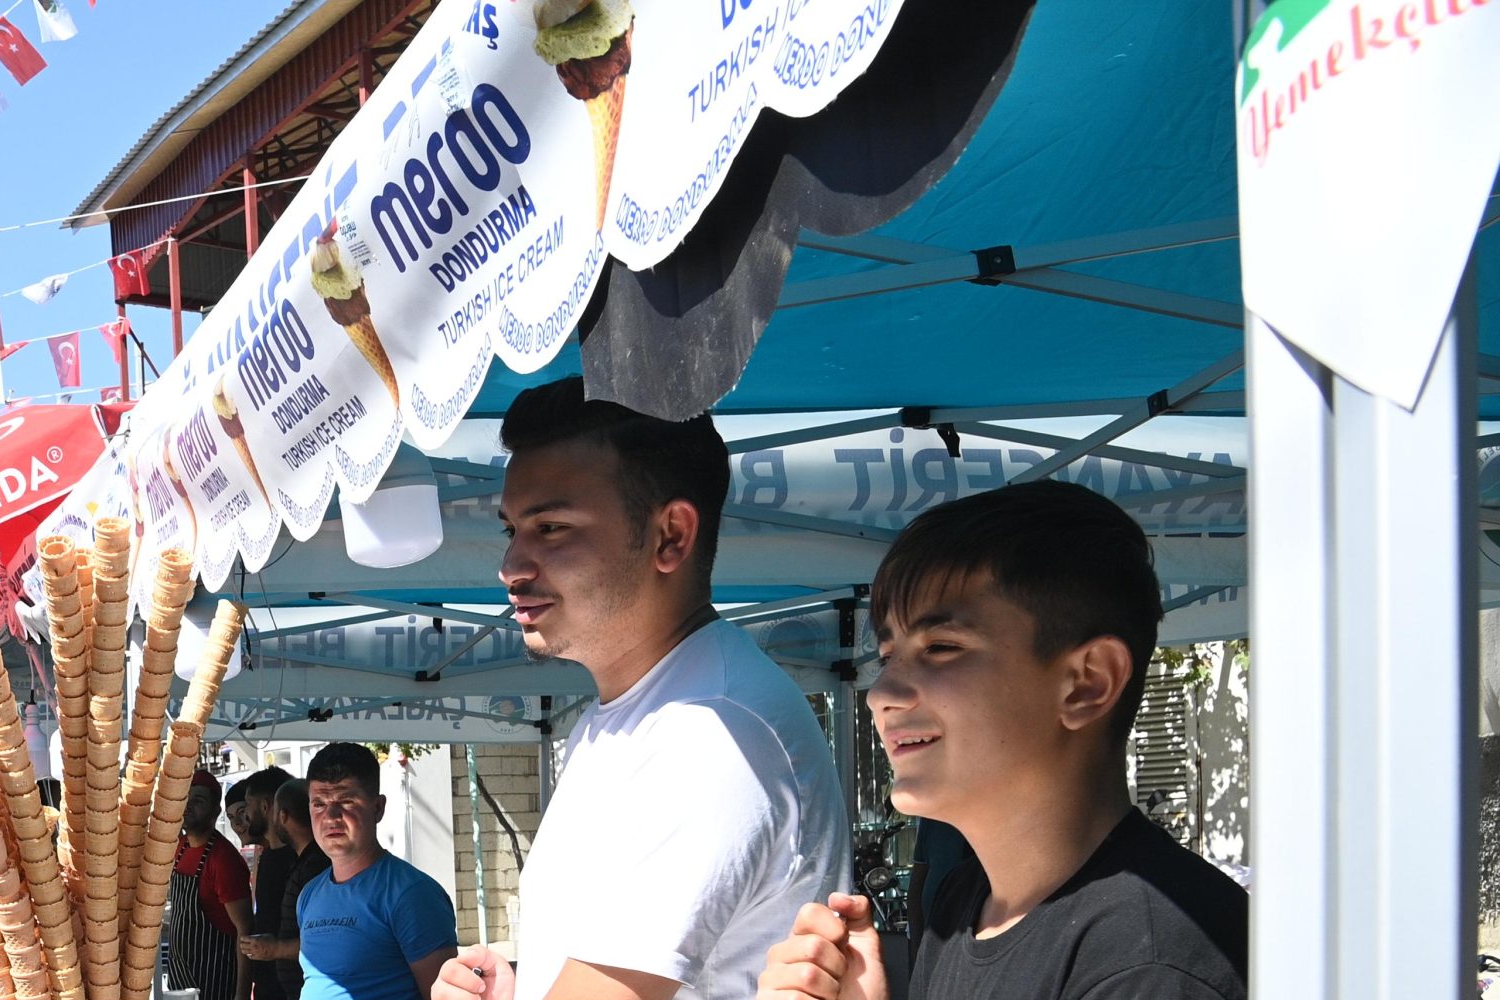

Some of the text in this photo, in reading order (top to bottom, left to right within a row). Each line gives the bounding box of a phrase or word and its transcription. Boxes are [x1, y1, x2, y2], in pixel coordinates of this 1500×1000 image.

[688, 6, 780, 123] TURKISH
[656, 81, 758, 242] DONDURMA
[429, 184, 538, 294] DONDURMA
[437, 214, 565, 350] TURKISH ICE CREAM
[534, 229, 605, 353] DONDURMA
[271, 374, 331, 435] DONDURMA
[281, 394, 368, 472] TURKISH ICE CREAM
